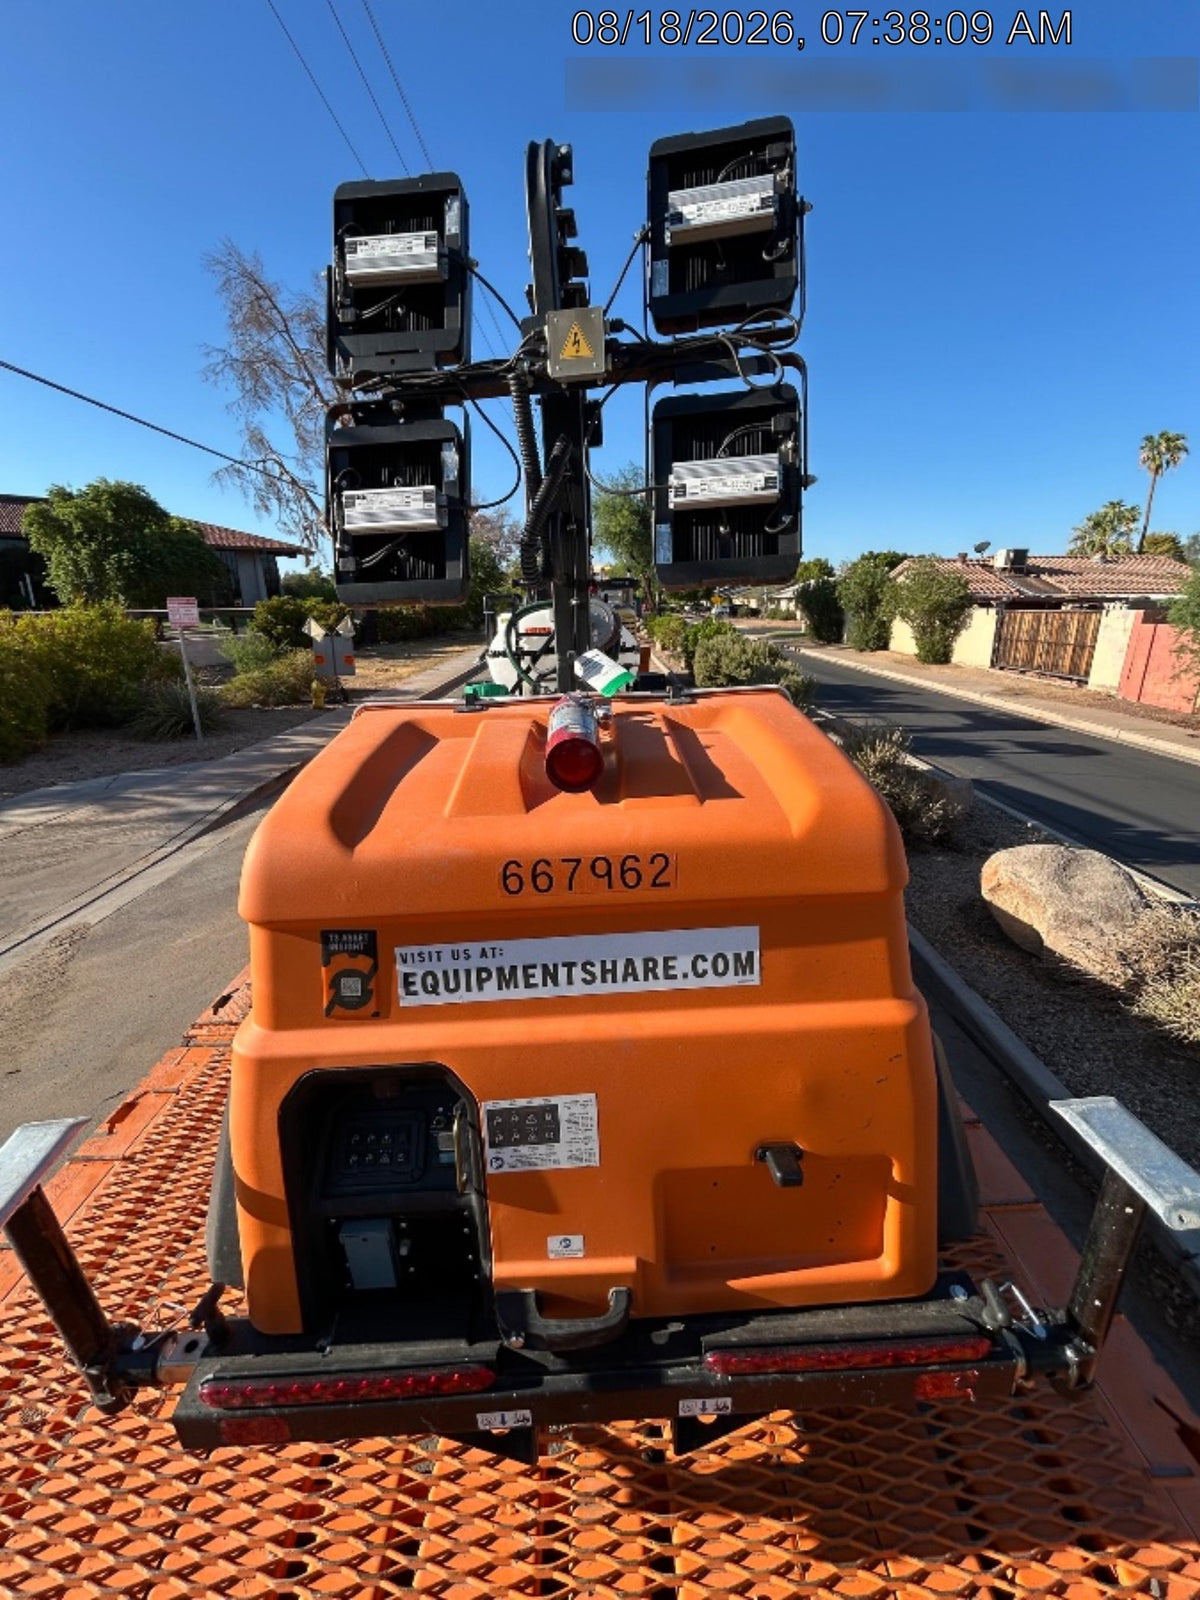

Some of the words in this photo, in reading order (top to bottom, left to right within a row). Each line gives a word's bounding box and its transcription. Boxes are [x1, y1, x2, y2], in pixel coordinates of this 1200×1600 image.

[502, 853, 671, 895] 667962
[400, 950, 442, 964] VISIT
[451, 949, 471, 961] US
[479, 947, 504, 959] AT:
[403, 951, 754, 996] EQUIPMENTSHARE.COM
